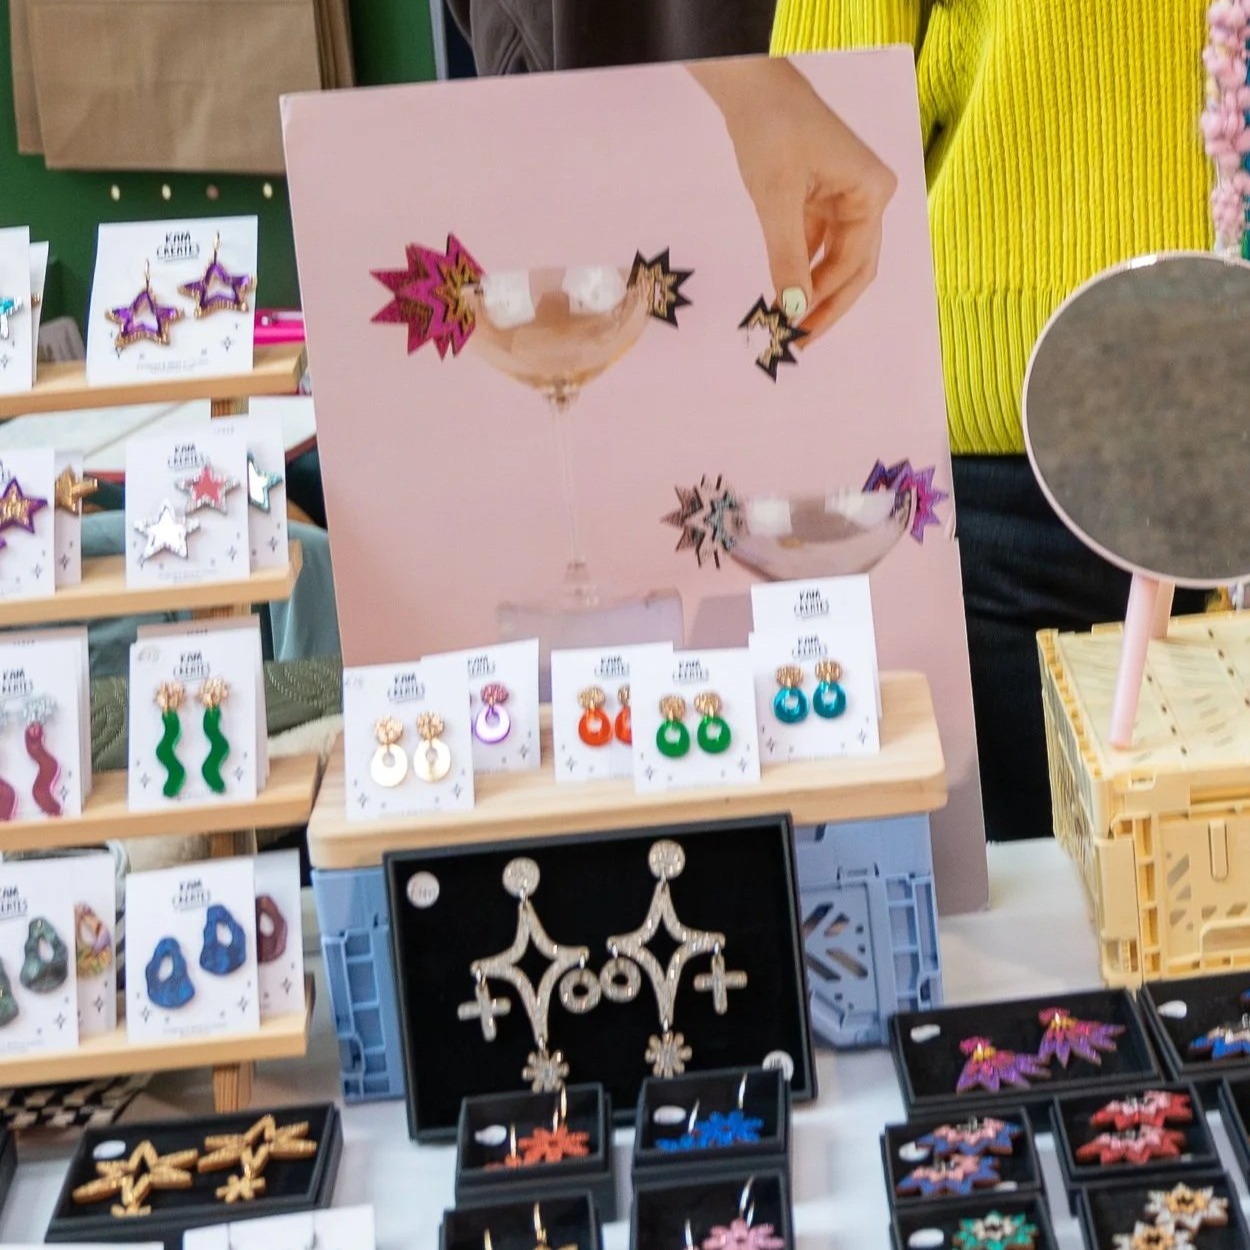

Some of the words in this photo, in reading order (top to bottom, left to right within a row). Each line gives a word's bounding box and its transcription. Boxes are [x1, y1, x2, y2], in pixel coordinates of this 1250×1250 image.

[165, 231, 191, 243] KAM
[156, 244, 200, 257] CREATES
[800, 591, 820, 602] KAM
[798, 636, 819, 647] KAM
[180, 651, 202, 663] KAM
[3, 669, 25, 681] KAM
[173, 664, 211, 678] CREATES
[395, 674, 416, 684] KAM
[179, 881, 202, 892] KAM
